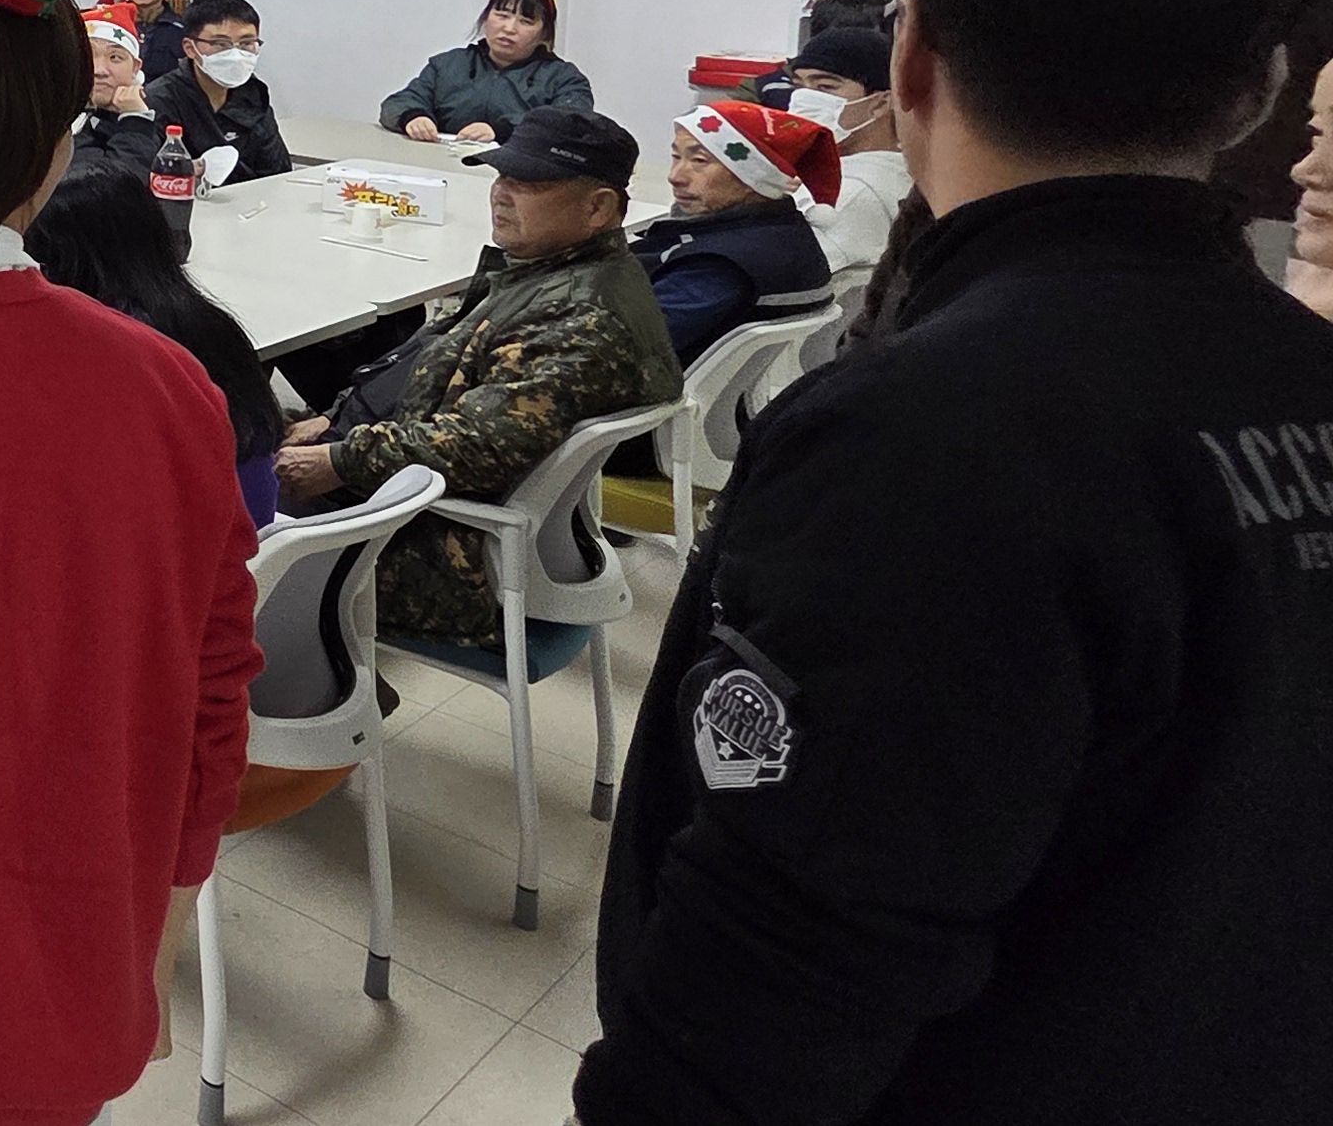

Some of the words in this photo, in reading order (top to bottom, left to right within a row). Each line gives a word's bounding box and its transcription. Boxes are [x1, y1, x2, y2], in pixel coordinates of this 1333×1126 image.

[1197, 422, 1333, 530] ACC
[707, 682, 788, 747] PURSUE
[709, 704, 771, 758] VALUE
